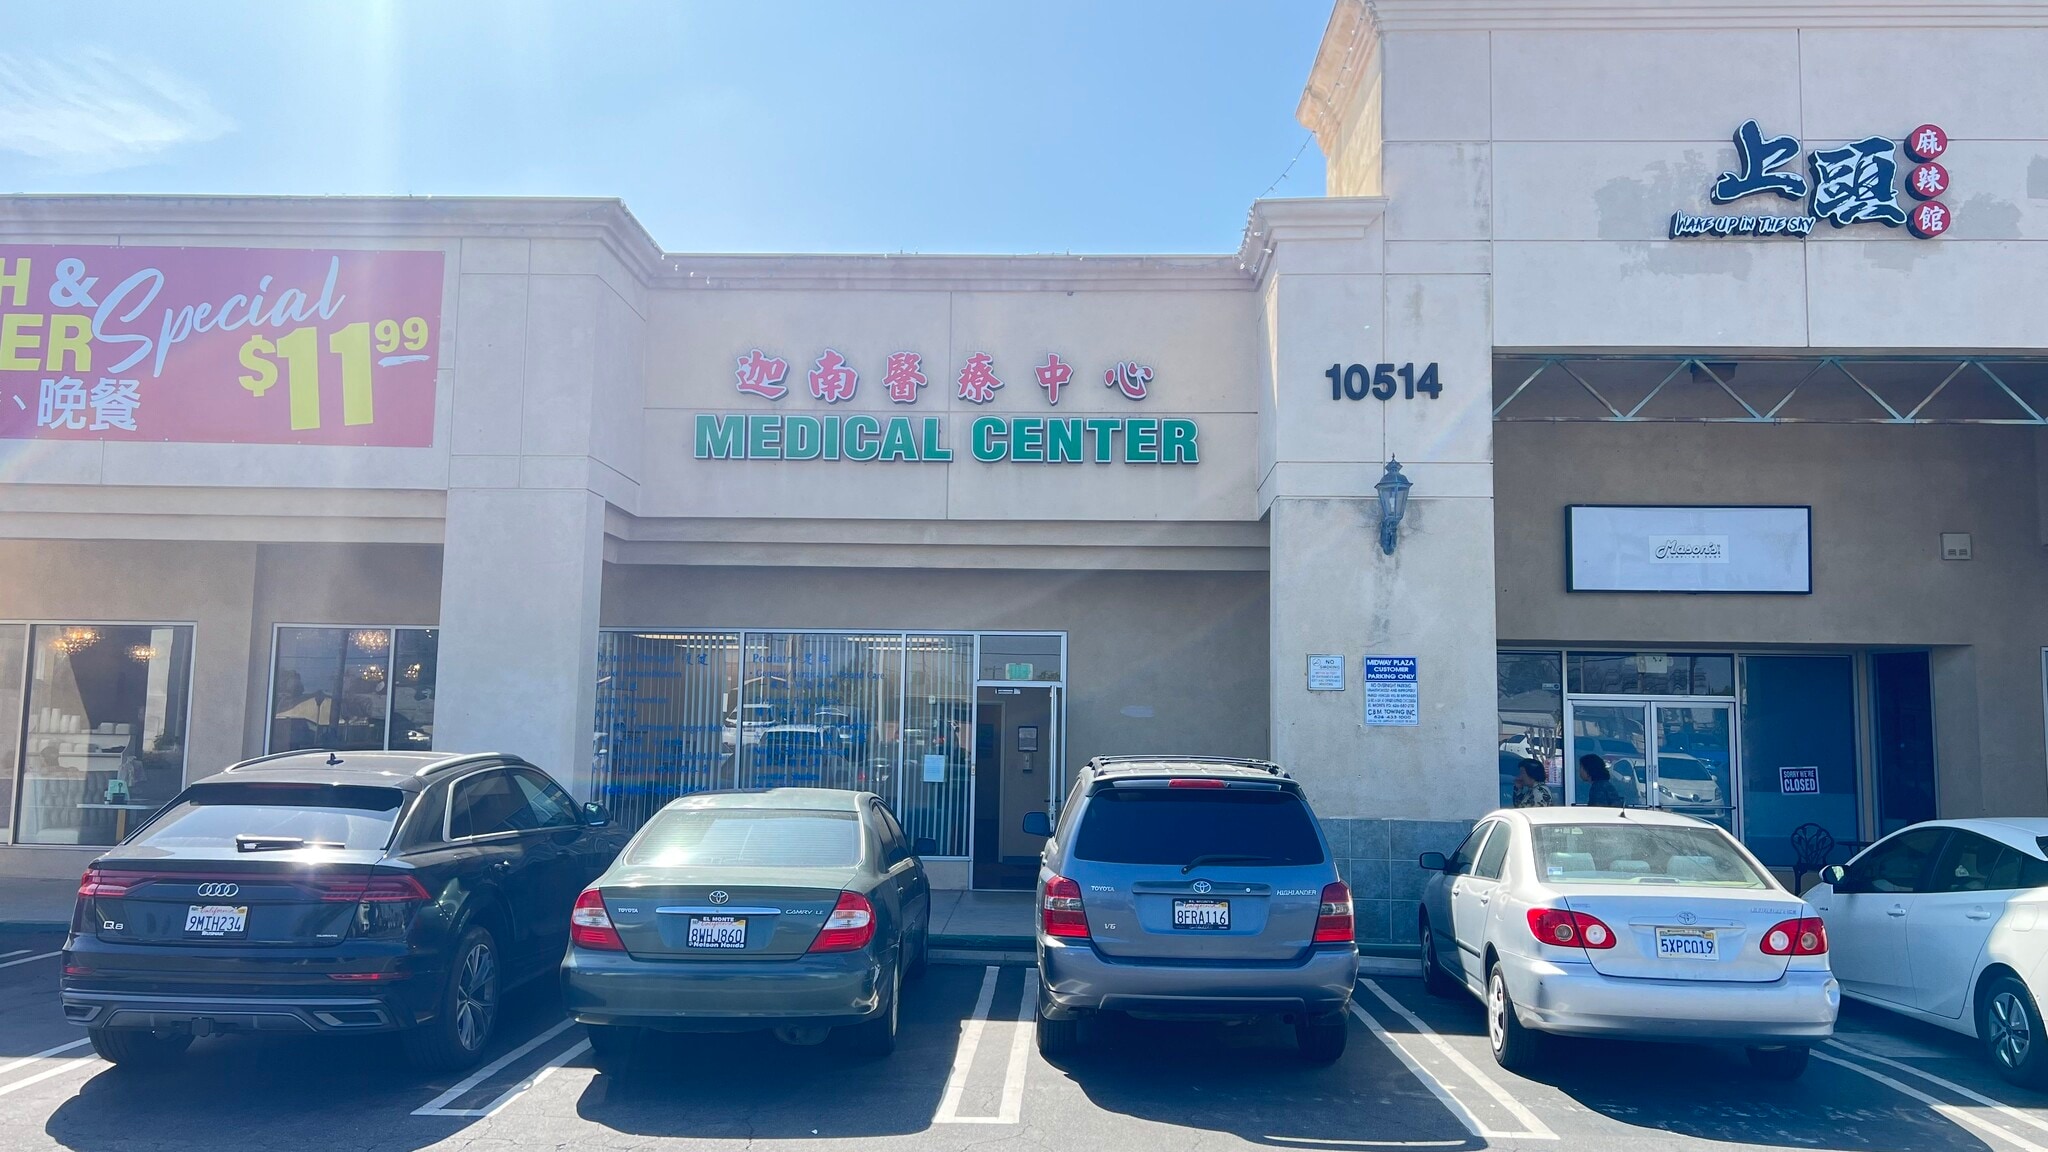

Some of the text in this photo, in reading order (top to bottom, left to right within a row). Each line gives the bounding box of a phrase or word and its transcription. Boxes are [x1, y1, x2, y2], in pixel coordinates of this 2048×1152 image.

[1712, 119, 1907, 226] 上頭
[1915, 129, 1946, 232] 麻辣館
[1674, 209, 1713, 235] WAKE
[1714, 215, 1739, 234] UP
[1758, 215, 1787, 233] THE
[1787, 215, 1817, 235] SKY
[49, 258, 99, 308] &
[92, 256, 345, 378] Special
[735, 348, 1154, 405] 迦南醫療中心
[1325, 362, 1443, 401] 10514
[694, 414, 1200, 465] MEDICAL CENTER
[1655, 539, 1717, 559] Mason's
[752, 653, 799, 665] Podiatry
[866, 670, 885, 680] Care
[1783, 770, 1800, 778] SORRY
[1784, 778, 1816, 792] CLOSED
[103, 920, 124, 930] Q8
[188, 915, 242, 931] 9MIH234
[1177, 910, 1226, 925] 8FRA116
[691, 928, 743, 943] 8WHJ860
[1661, 939, 1714, 954] 5XPC019
